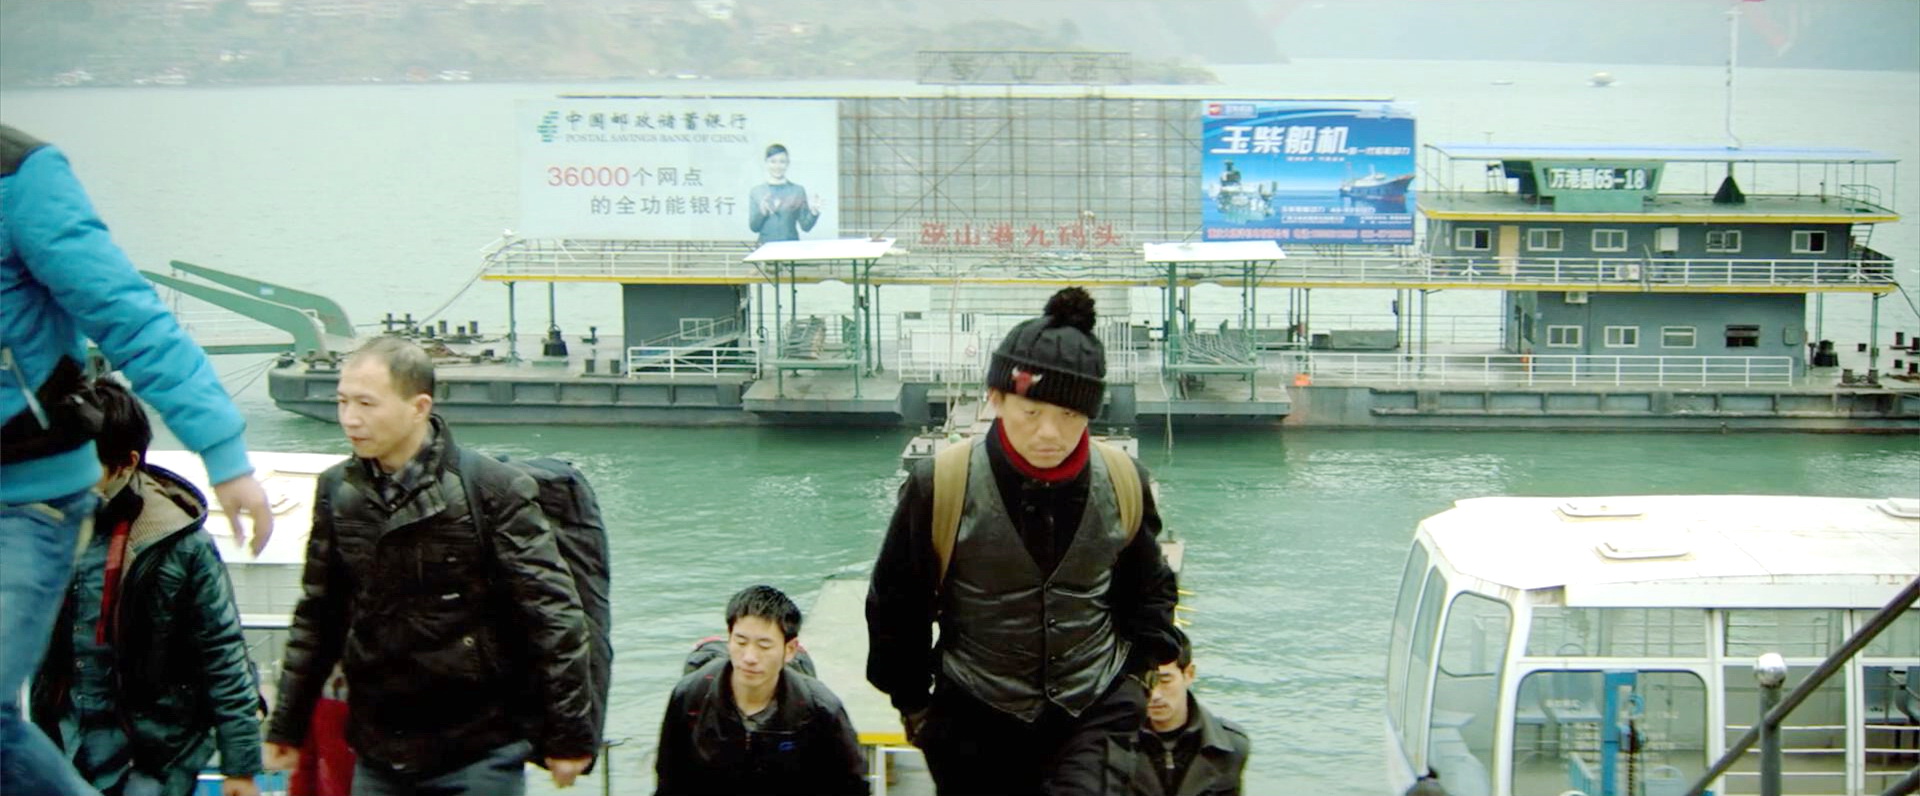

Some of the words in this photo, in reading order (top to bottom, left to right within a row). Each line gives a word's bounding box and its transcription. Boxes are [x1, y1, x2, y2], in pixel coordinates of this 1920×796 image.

[566, 110, 747, 131] 中国邮政储蓄银行
[566, 134, 608, 143] POSTAL
[611, 134, 657, 143] SAVINGS
[659, 134, 692, 143] BANK
[695, 134, 709, 143] OF
[711, 134, 748, 143] CHINA
[1209, 125, 1350, 154] 玉柴船机
[548, 165, 704, 187] 36000个网点
[590, 195, 736, 215] 的全功能银行
[919, 221, 1122, 248] 巫山港九码头
